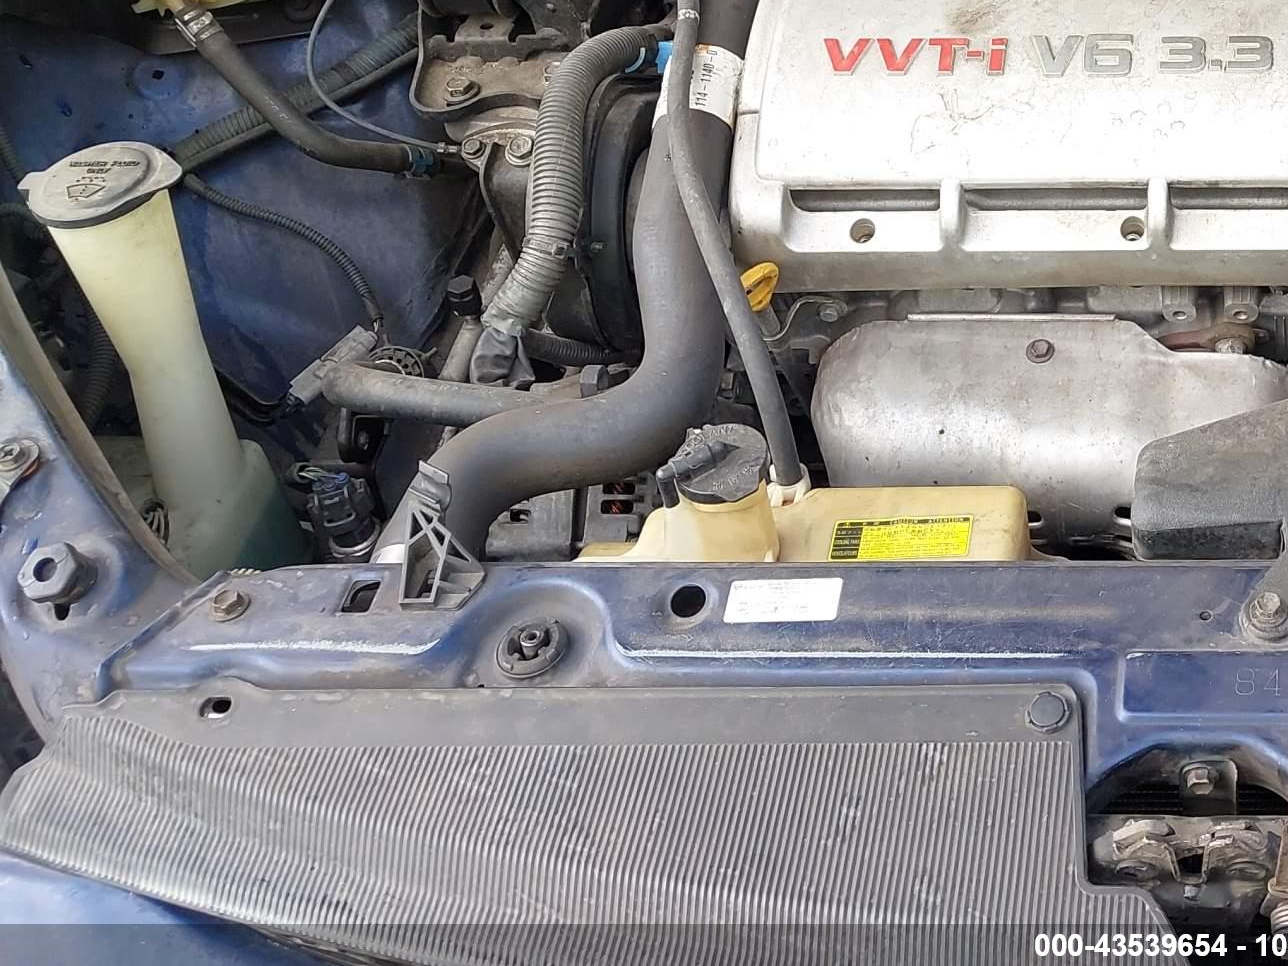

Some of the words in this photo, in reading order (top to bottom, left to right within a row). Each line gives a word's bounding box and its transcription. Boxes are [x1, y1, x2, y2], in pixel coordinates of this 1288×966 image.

[823, 35, 1009, 76] VVT-i
[1031, 34, 1136, 77] V6
[1158, 34, 1274, 76] 3.3
